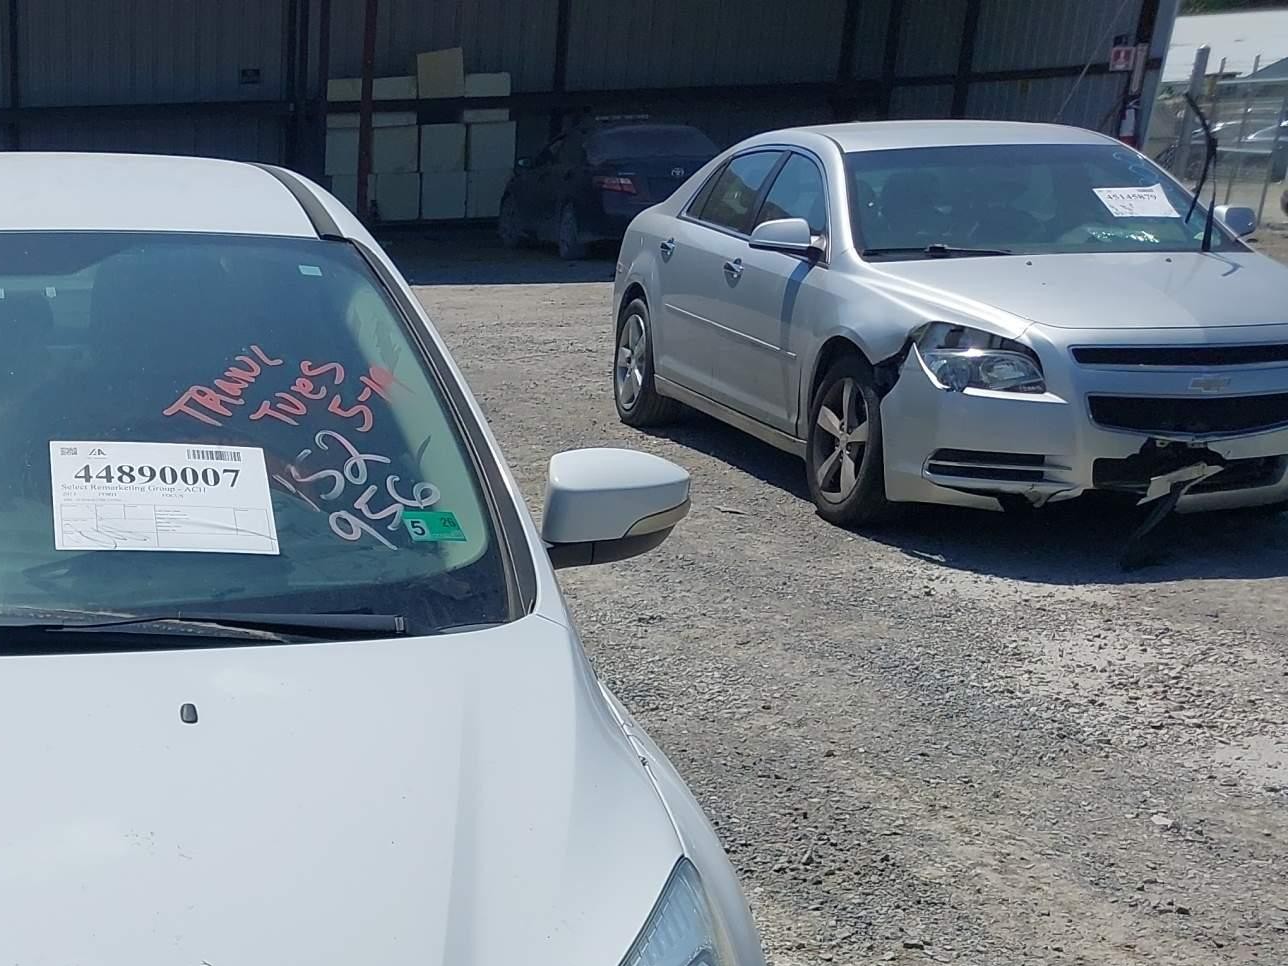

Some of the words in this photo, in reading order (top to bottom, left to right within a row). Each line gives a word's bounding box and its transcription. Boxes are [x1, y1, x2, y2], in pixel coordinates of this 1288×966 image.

[73, 463, 241, 488] 44890007
[328, 474, 441, 551] 956
[410, 520, 426, 536] 5
[441, 516, 456, 528] 26
